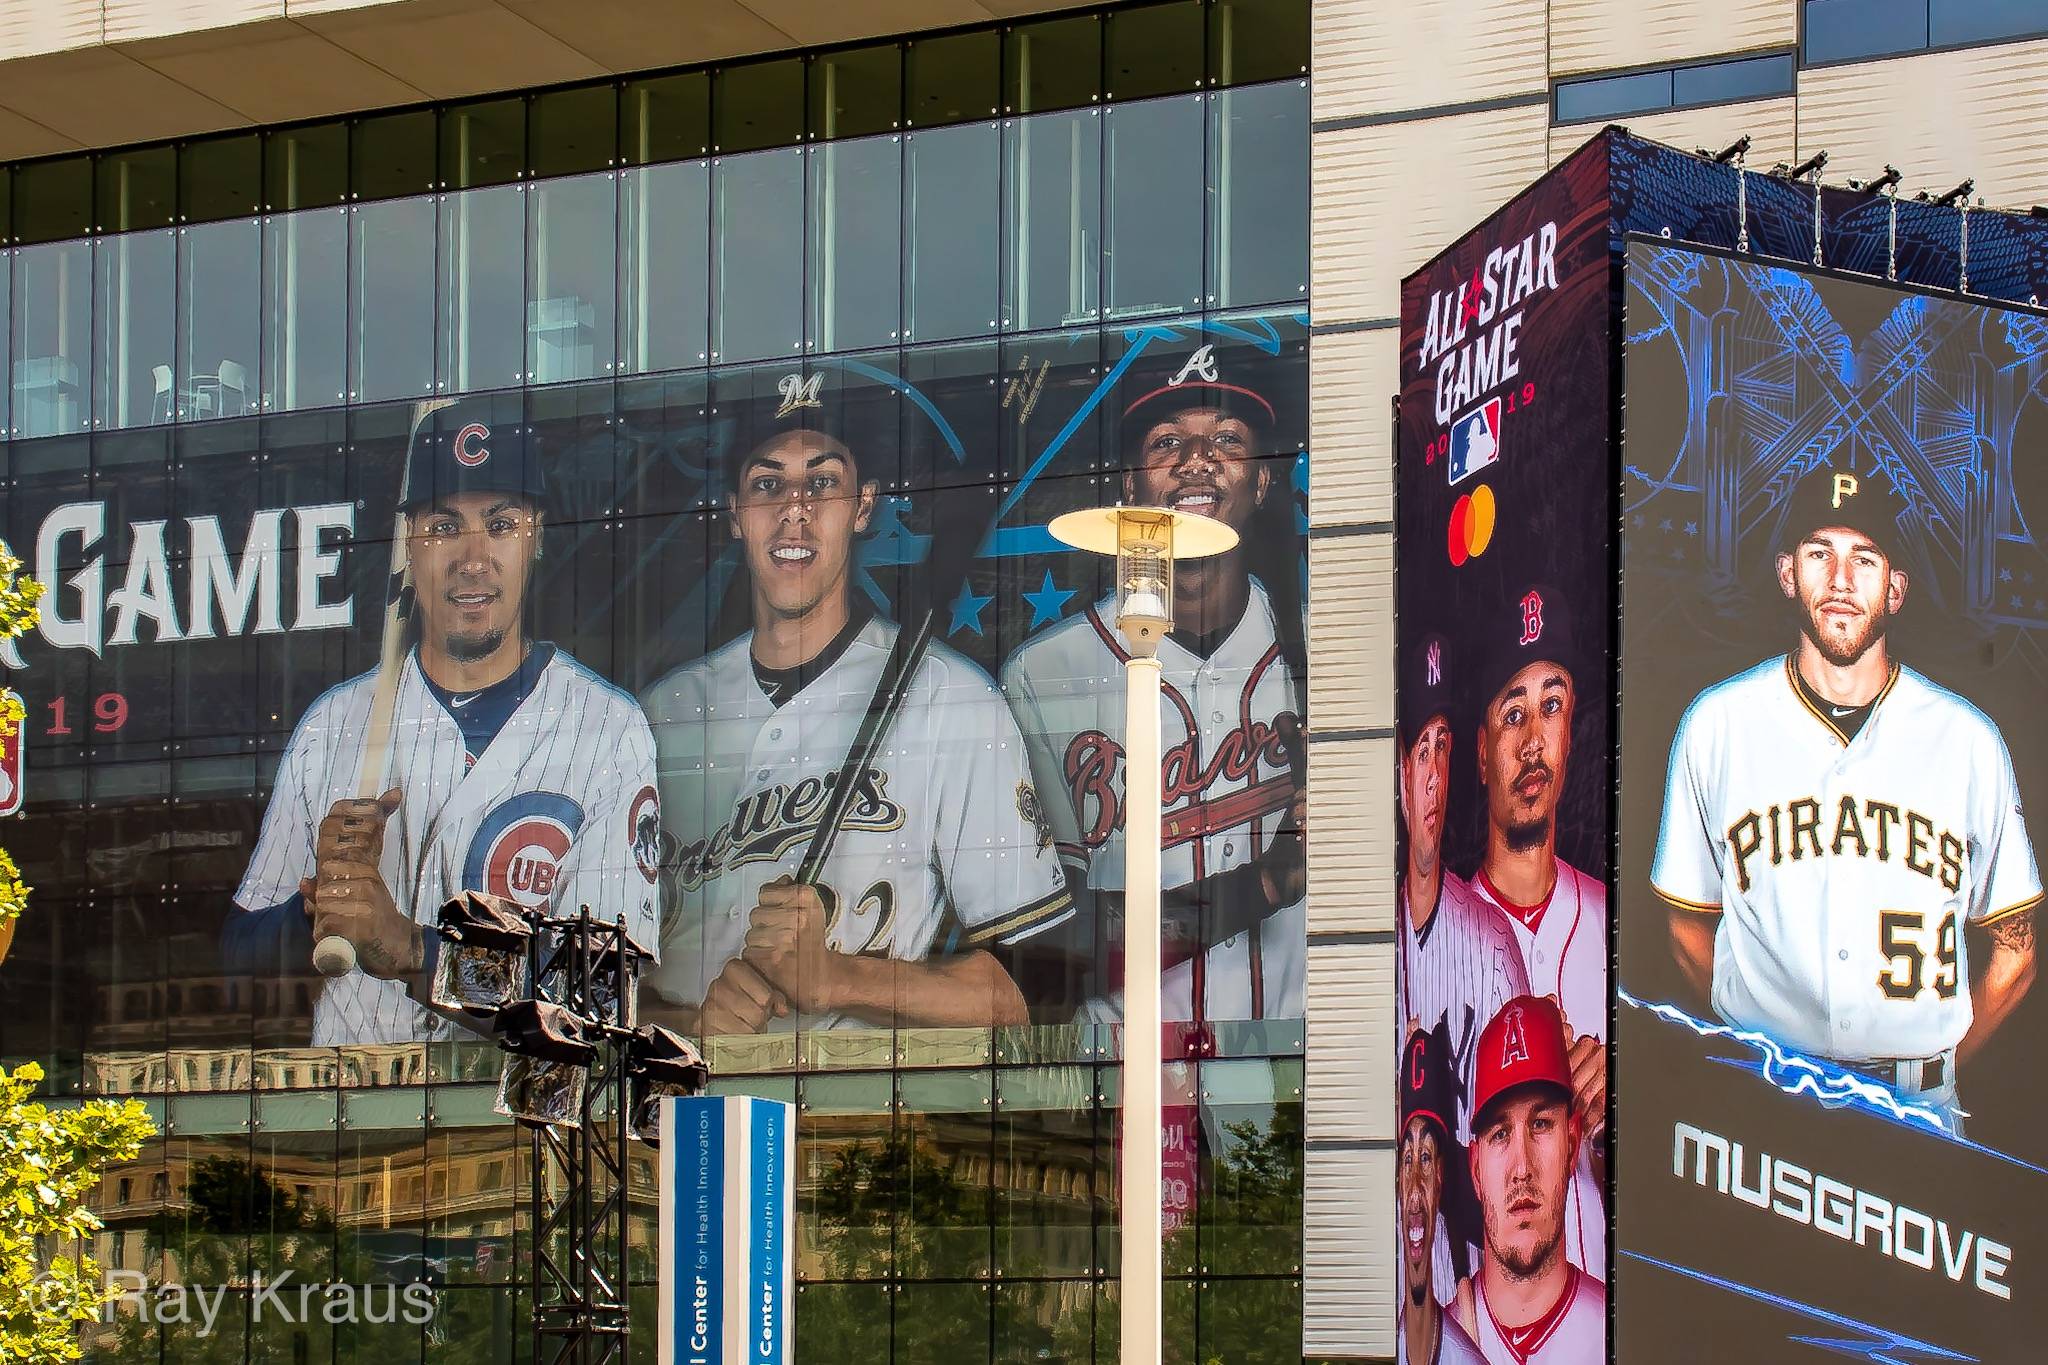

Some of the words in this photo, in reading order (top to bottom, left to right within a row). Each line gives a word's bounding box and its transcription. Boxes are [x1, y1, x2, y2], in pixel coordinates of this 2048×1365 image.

[1477, 220, 1561, 326] STAR
[776, 371, 824, 419] M
[1168, 344, 1219, 387] A
[1435, 308, 1525, 427] GAME
[454, 422, 490, 467] C
[1832, 472, 1859, 510] P
[36, 500, 357, 661] GAME
[1519, 590, 1544, 646] B
[1726, 794, 1967, 894] PIRATES
[1877, 909, 1958, 1003] 59
[1411, 1038, 1426, 1091] C
[1500, 1004, 1530, 1070] A
[696, 1110, 709, 1190] Innovation
[764, 1117, 775, 1197] Innovation
[696, 1194, 709, 1244] Health
[764, 1201, 773, 1250] Health
[1672, 1120, 2013, 1301] MUSGROVE
[695, 1247, 708, 1270] for
[764, 1255, 773, 1276] for
[690, 1275, 708, 1351] Center
[760, 1281, 773, 1357] Center
